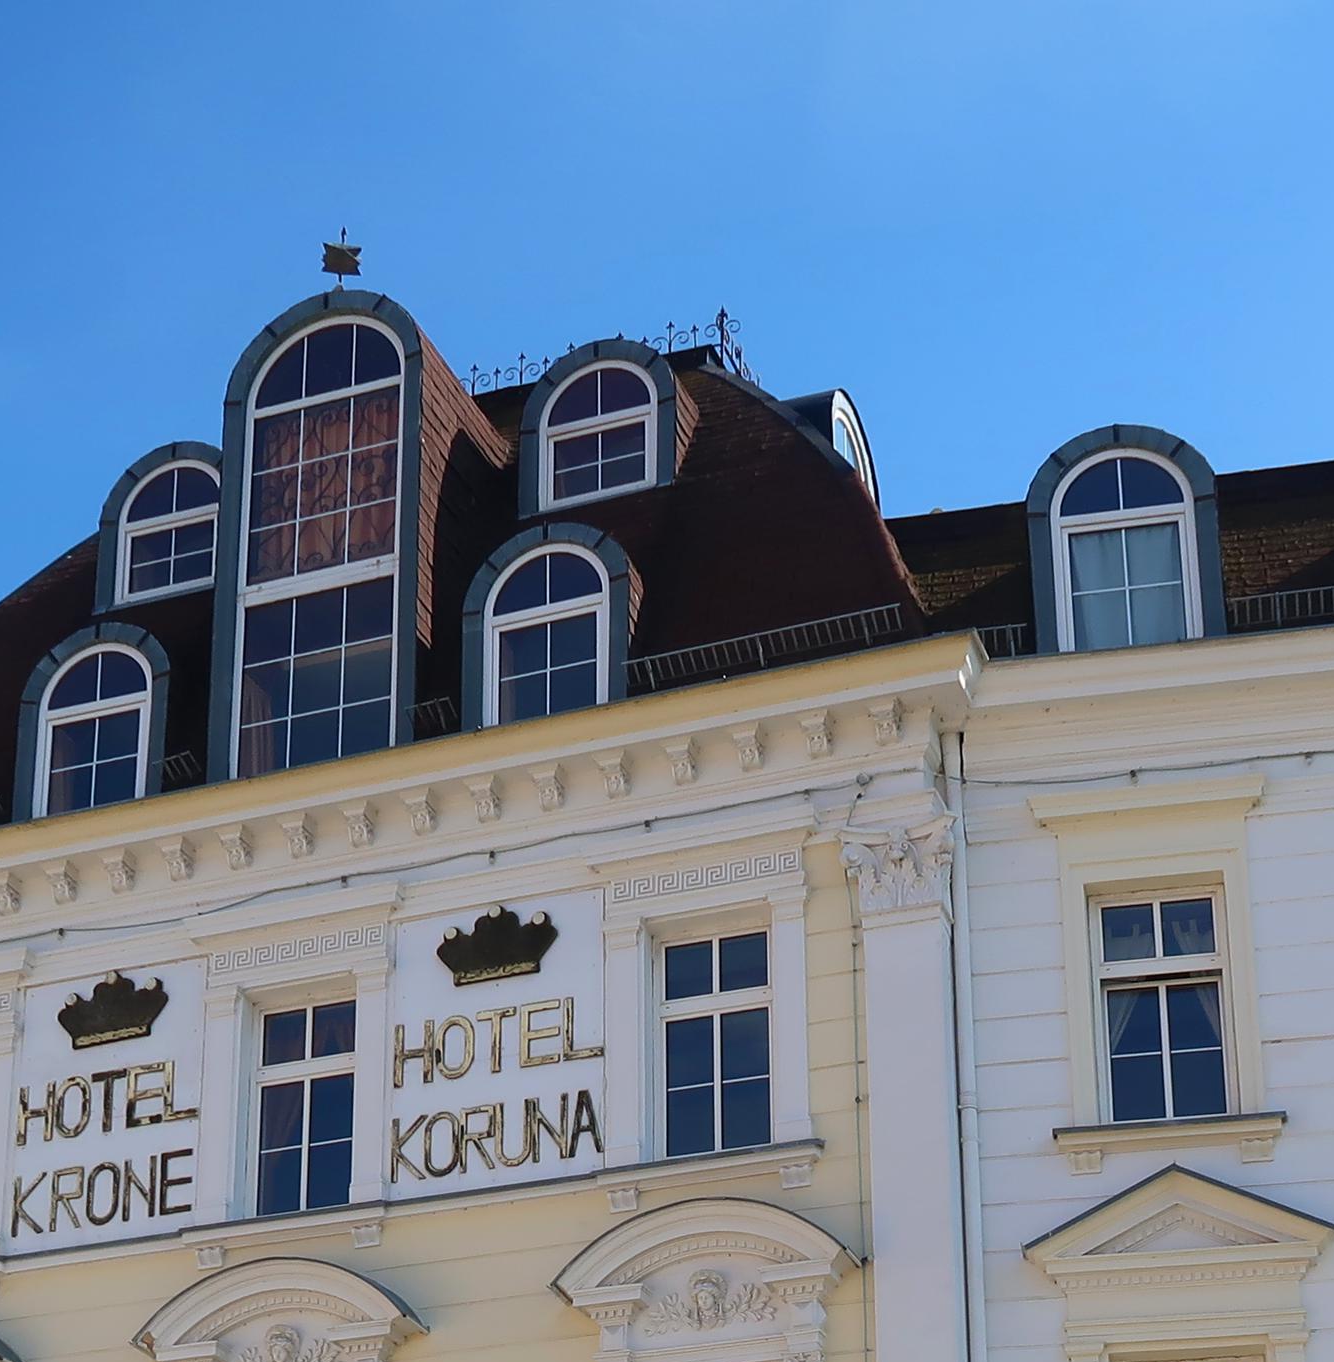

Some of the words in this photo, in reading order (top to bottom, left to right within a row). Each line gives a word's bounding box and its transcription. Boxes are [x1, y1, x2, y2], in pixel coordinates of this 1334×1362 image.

[393, 997, 605, 1088] HOTEL
[17, 1060, 200, 1146] HOTEL
[390, 1089, 604, 1183] KORUNA
[11, 1148, 193, 1237] KRONE
